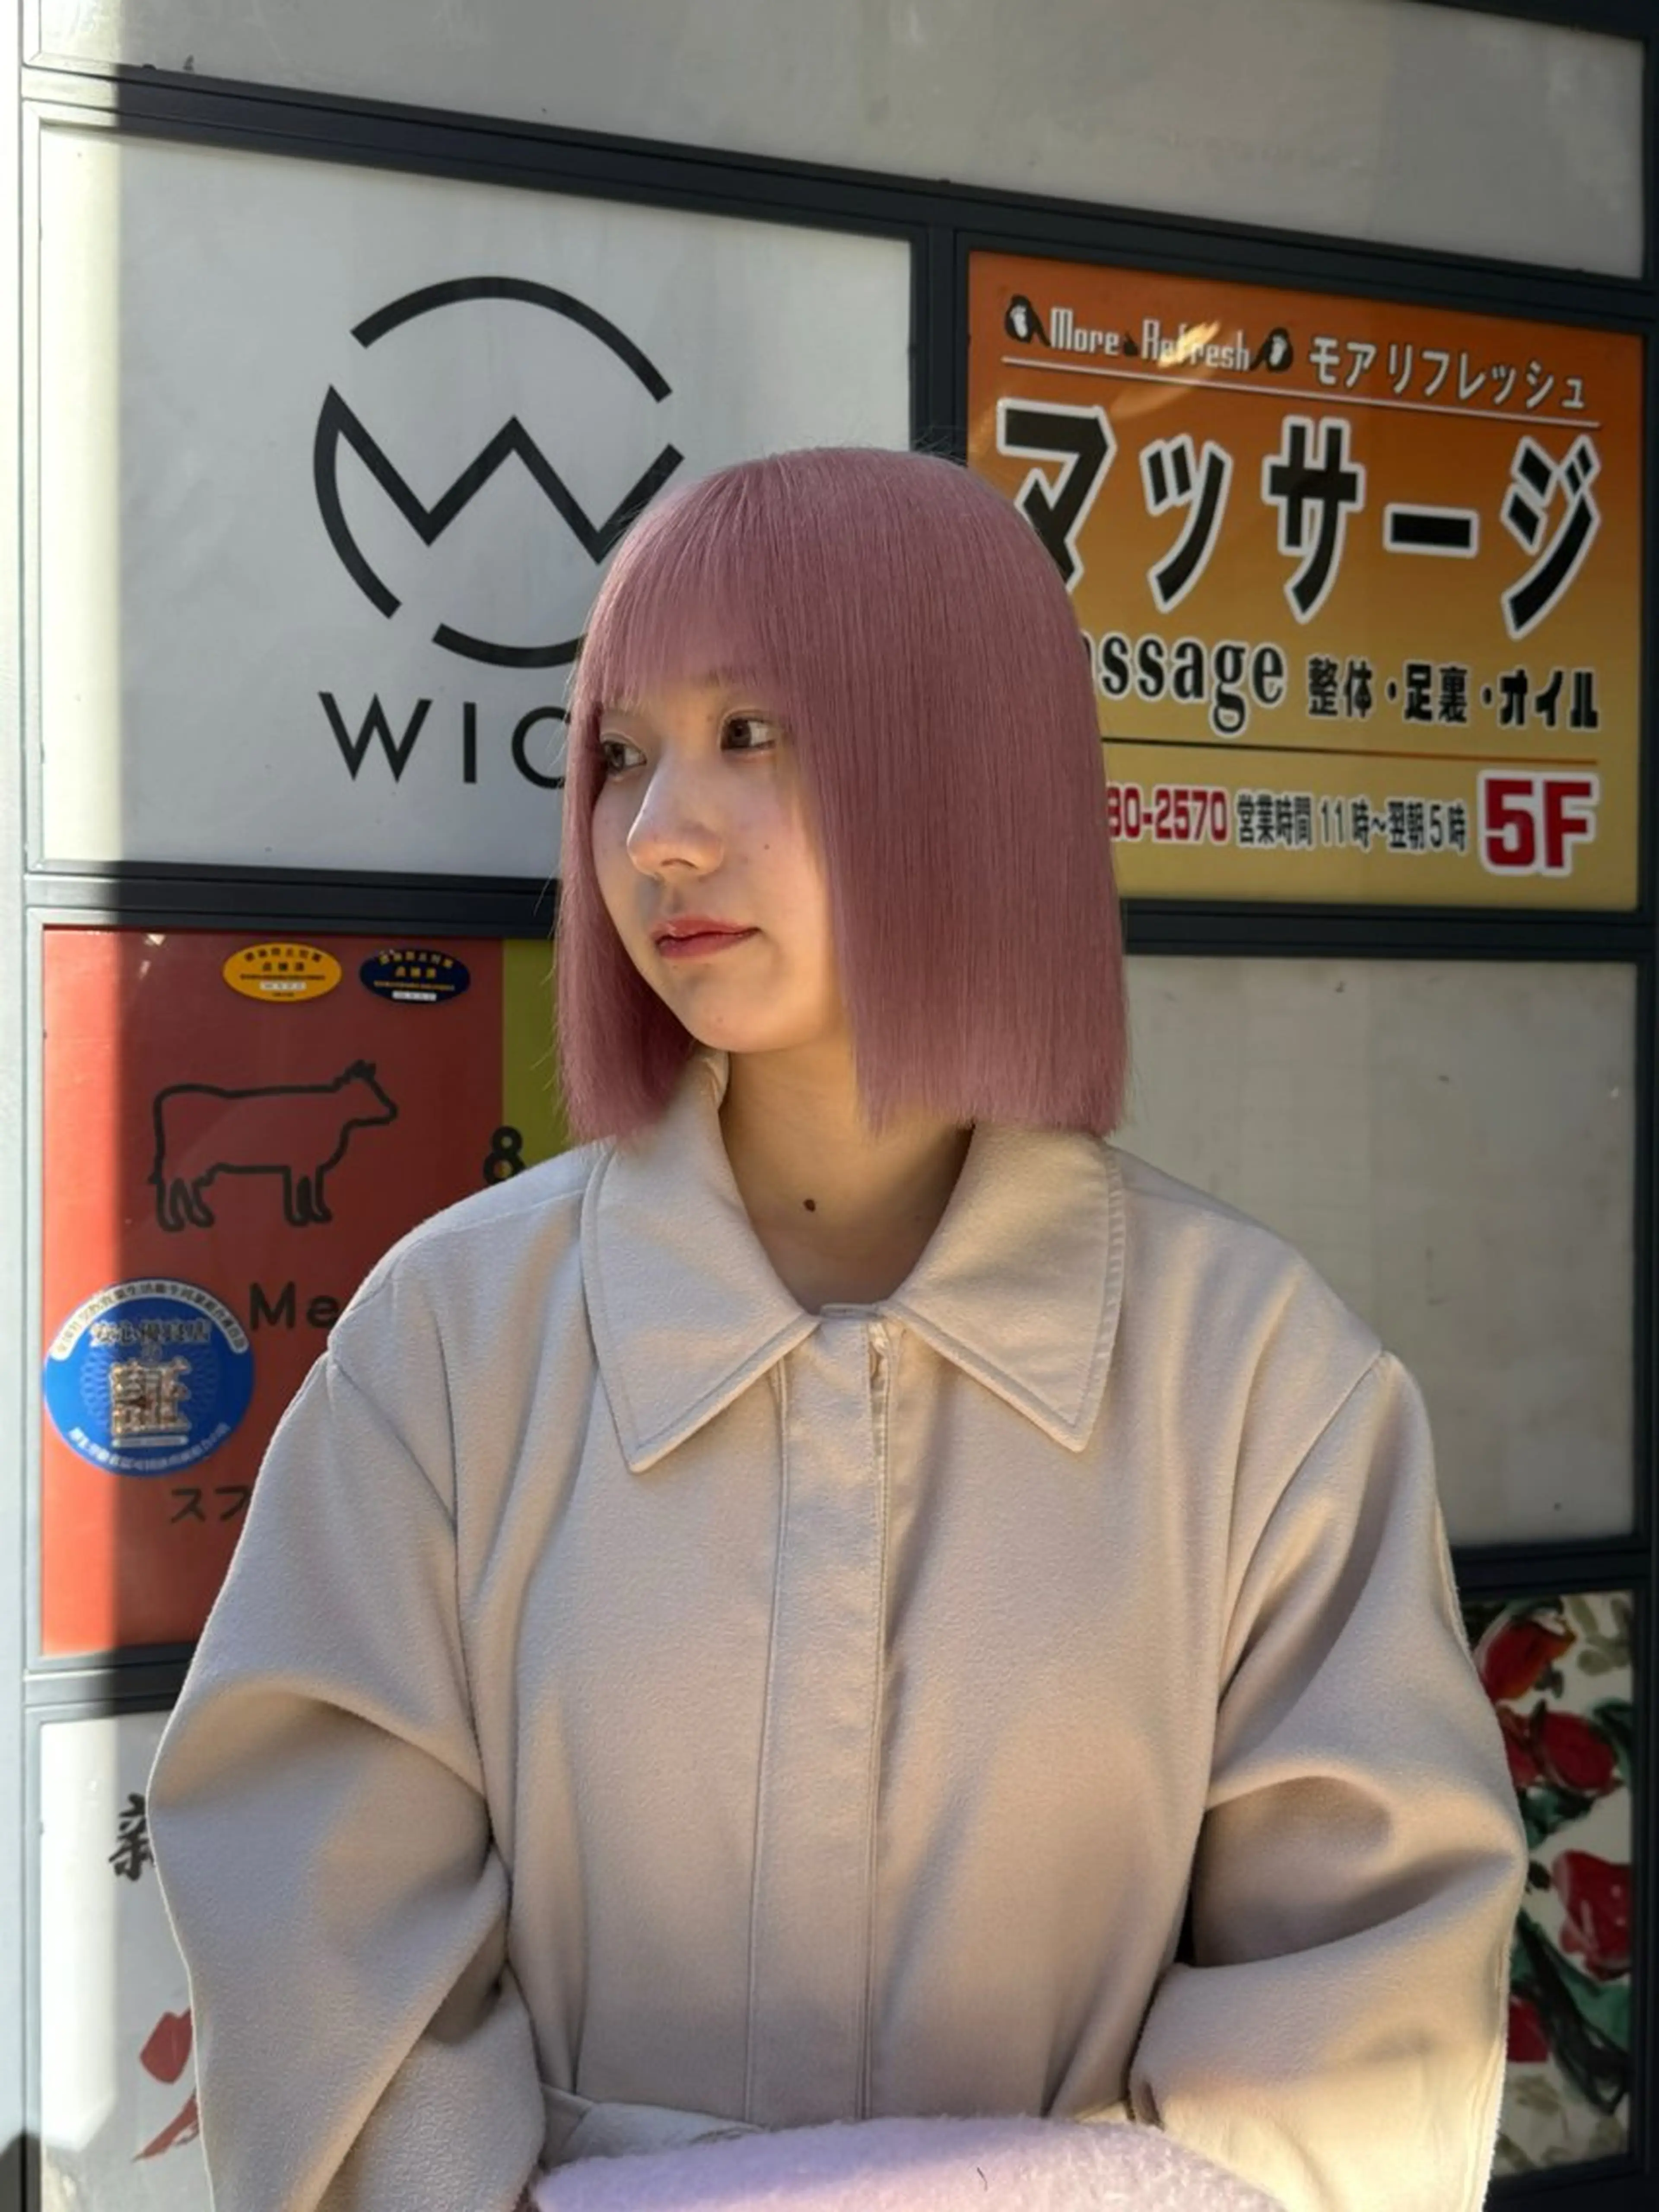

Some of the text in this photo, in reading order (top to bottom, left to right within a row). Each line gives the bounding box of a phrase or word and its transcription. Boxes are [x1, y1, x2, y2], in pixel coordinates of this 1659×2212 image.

[1051, 306, 1119, 356] More
[1309, 336, 1585, 409] モアリフレッシュ
[998, 400, 1600, 639] マッサージ
[1082, 632, 1285, 735] ssage
[1484, 778, 1592, 869] 5F
